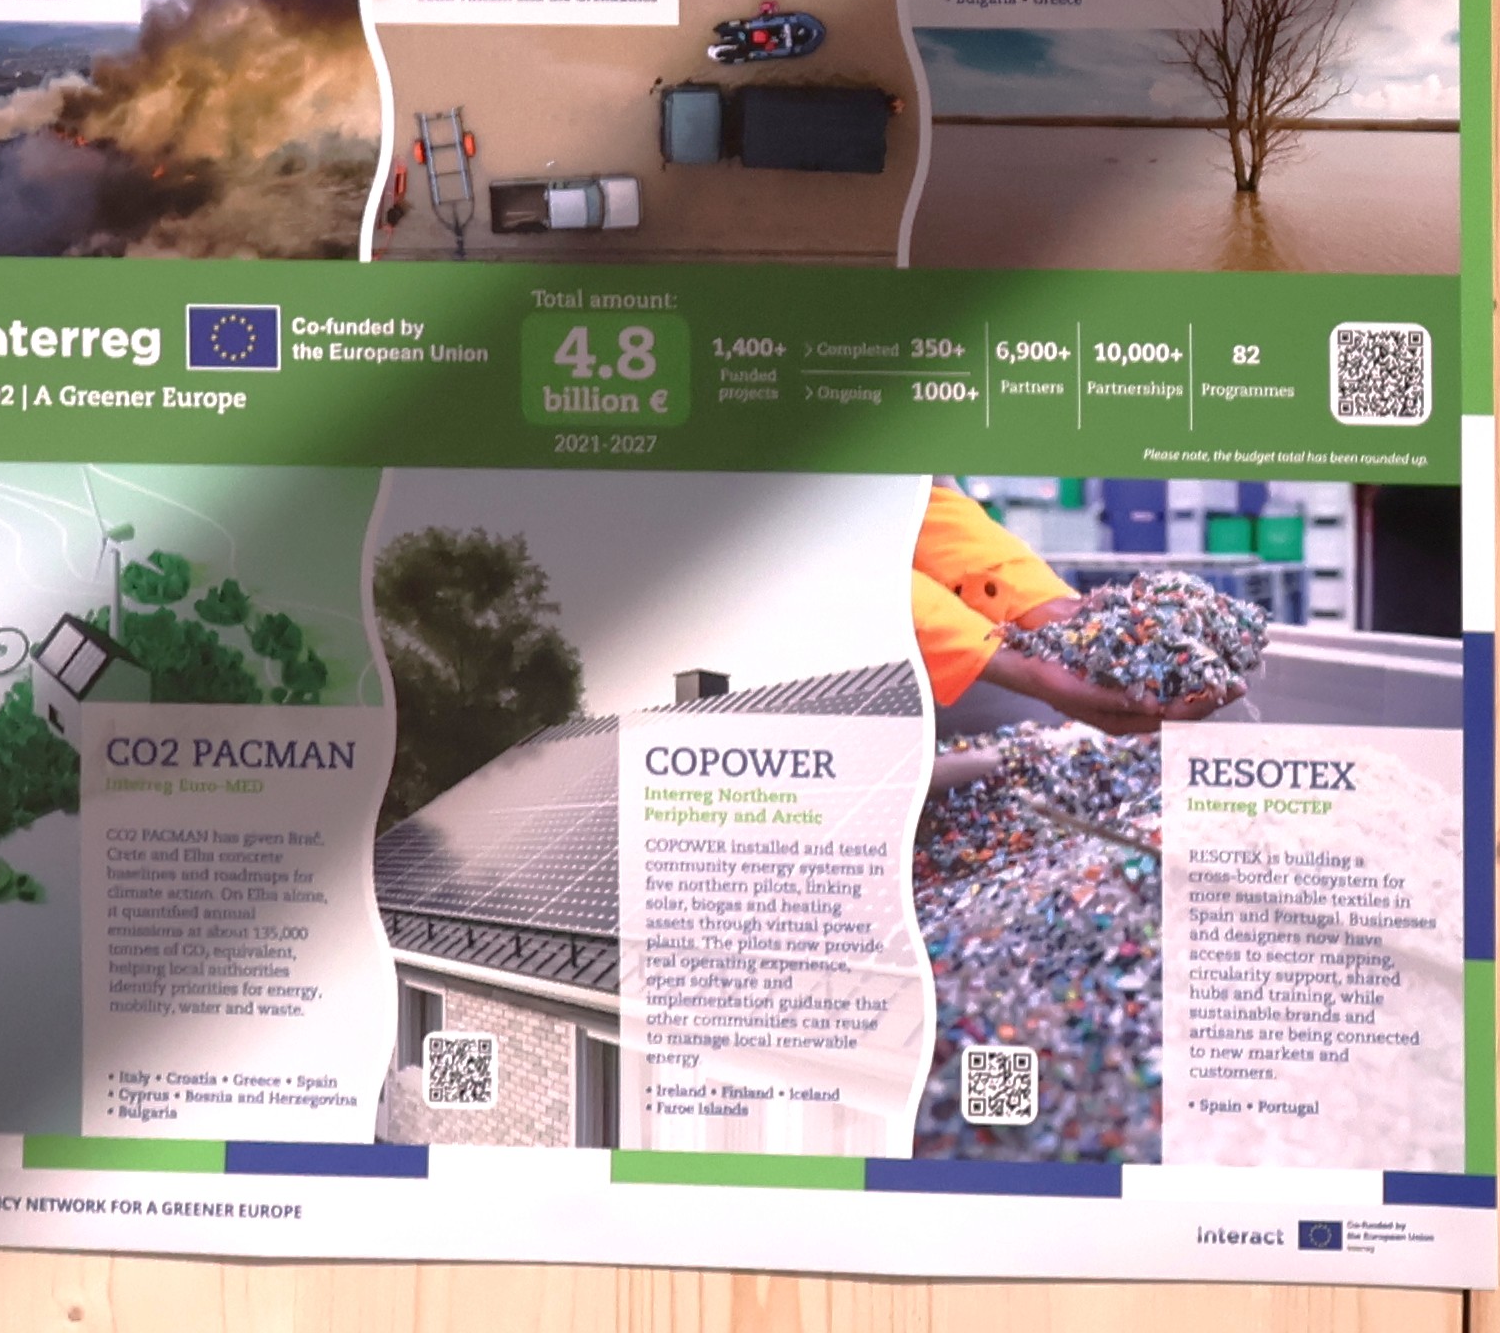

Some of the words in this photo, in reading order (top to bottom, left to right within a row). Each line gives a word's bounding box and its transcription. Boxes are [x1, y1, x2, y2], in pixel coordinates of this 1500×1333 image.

[553, 325, 657, 381] 4.8
[712, 336, 787, 361] 1,400+
[910, 337, 966, 358] 350+
[995, 340, 1071, 365] 6,900+
[1093, 341, 1183, 367] 10,000+
[1231, 344, 1260, 365] 82
[32, 384, 53, 406] A
[58, 384, 156, 408] Greener
[161, 386, 247, 415] Europe
[105, 737, 179, 767] CO2
[192, 738, 356, 770] PACMAN
[645, 746, 836, 779] COPOWER
[1187, 756, 1356, 791] RESOTEX
[25, 1197, 107, 1215] NETWORK
[110, 1199, 142, 1215] FOR
[145, 1200, 158, 1215] A
[161, 1200, 234, 1218] GREENER
[238, 1202, 301, 1220] EUROPE
